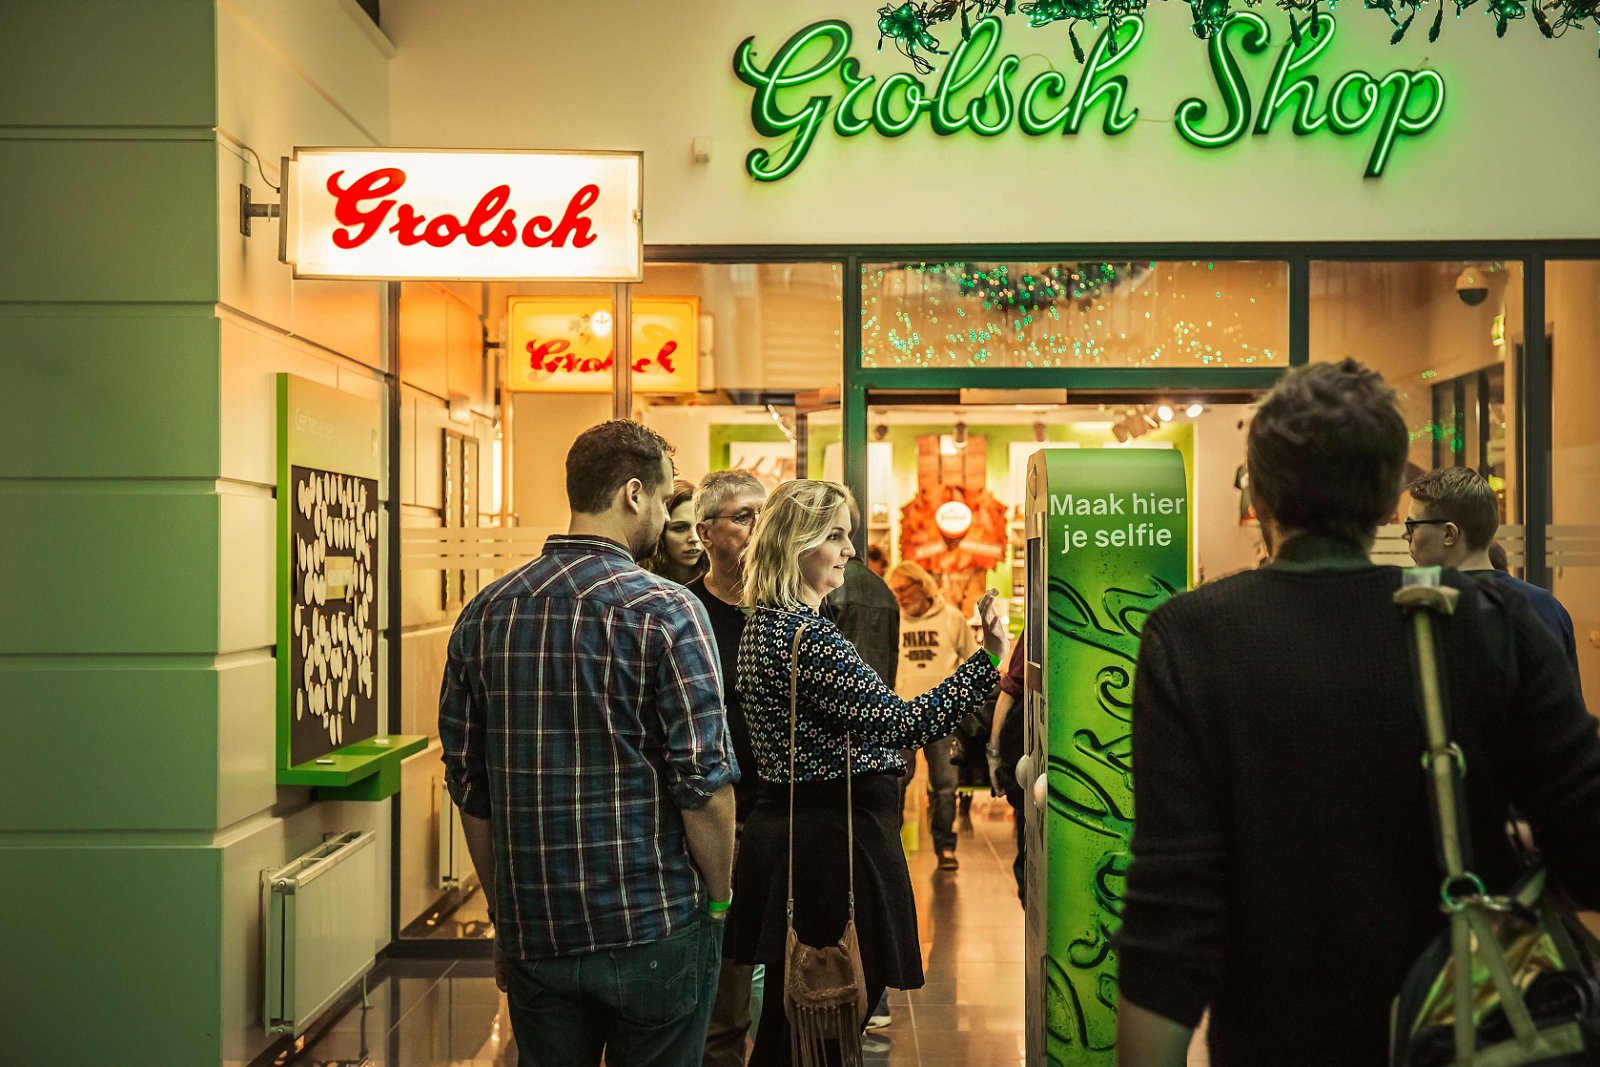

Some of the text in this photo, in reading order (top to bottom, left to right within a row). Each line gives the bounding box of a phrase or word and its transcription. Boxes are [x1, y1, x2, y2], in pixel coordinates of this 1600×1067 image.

[732, 9, 1447, 182] Grolsch Shop
[326, 166, 601, 250] Grolsch
[1049, 491, 1186, 517] Maak hier
[1061, 522, 1173, 554] je selfie
